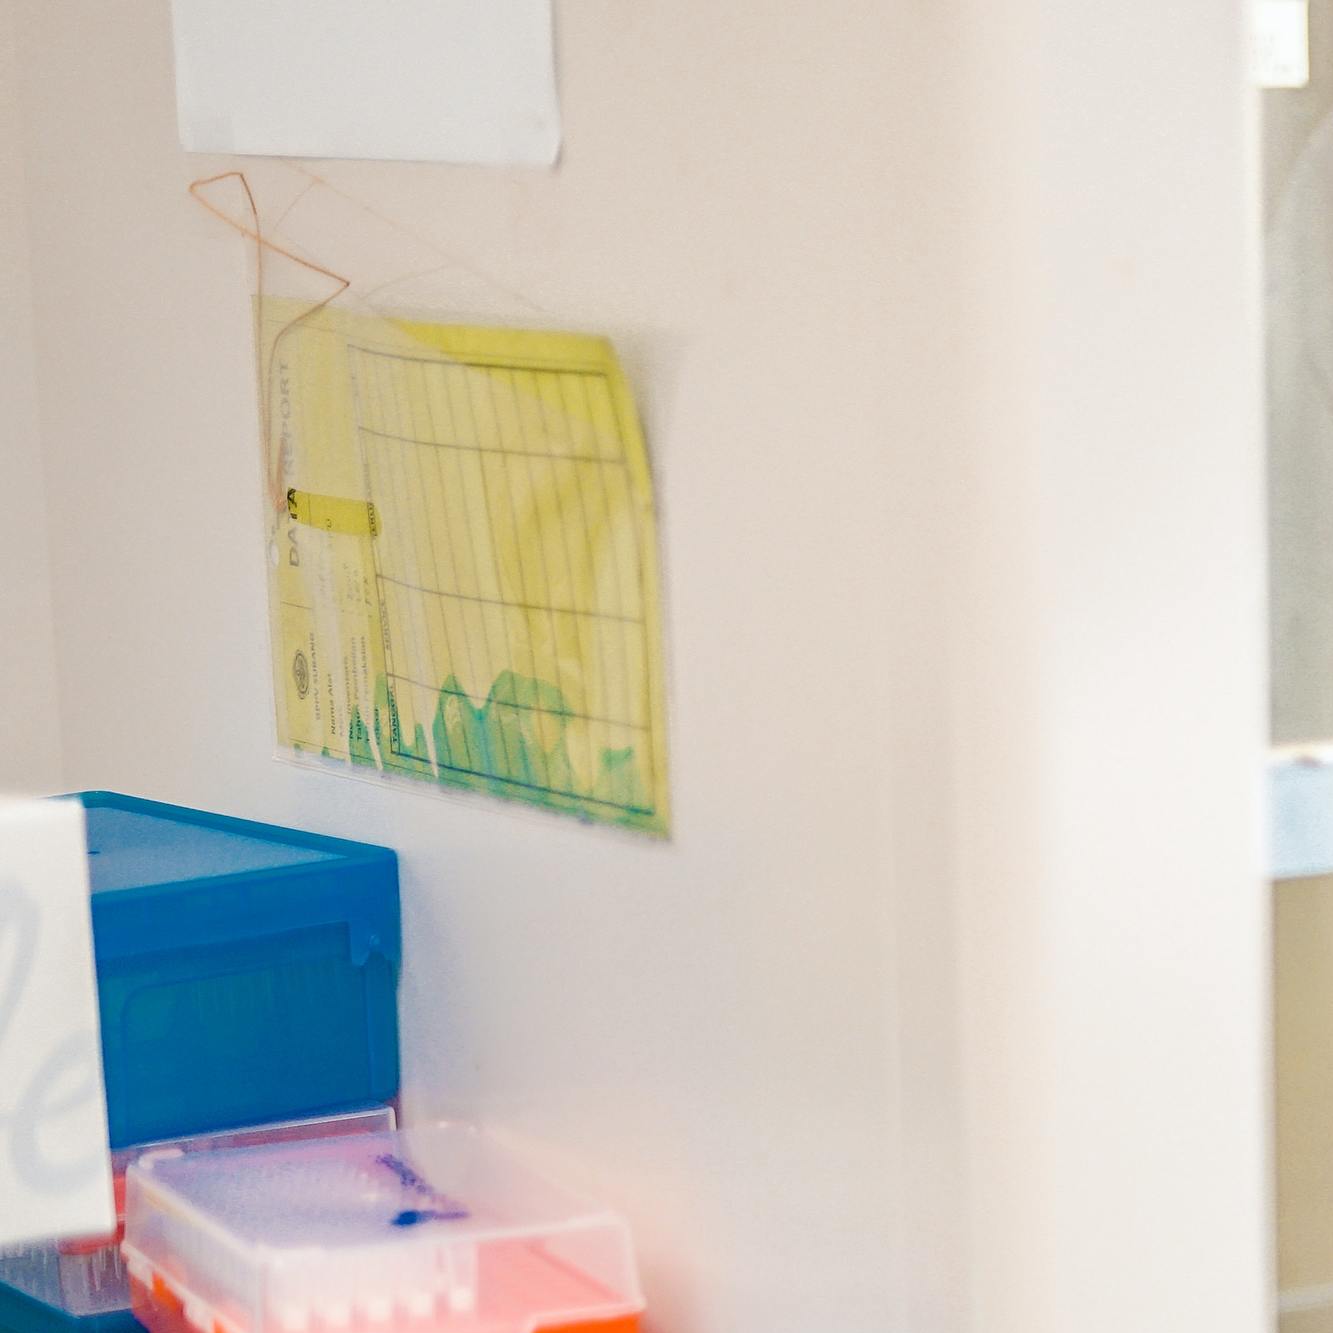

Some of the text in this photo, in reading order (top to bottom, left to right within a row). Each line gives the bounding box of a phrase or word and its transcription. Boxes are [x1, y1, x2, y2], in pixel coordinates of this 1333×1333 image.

[279, 363, 300, 567] DATA REPORT
[328, 699, 336, 735] Nama
